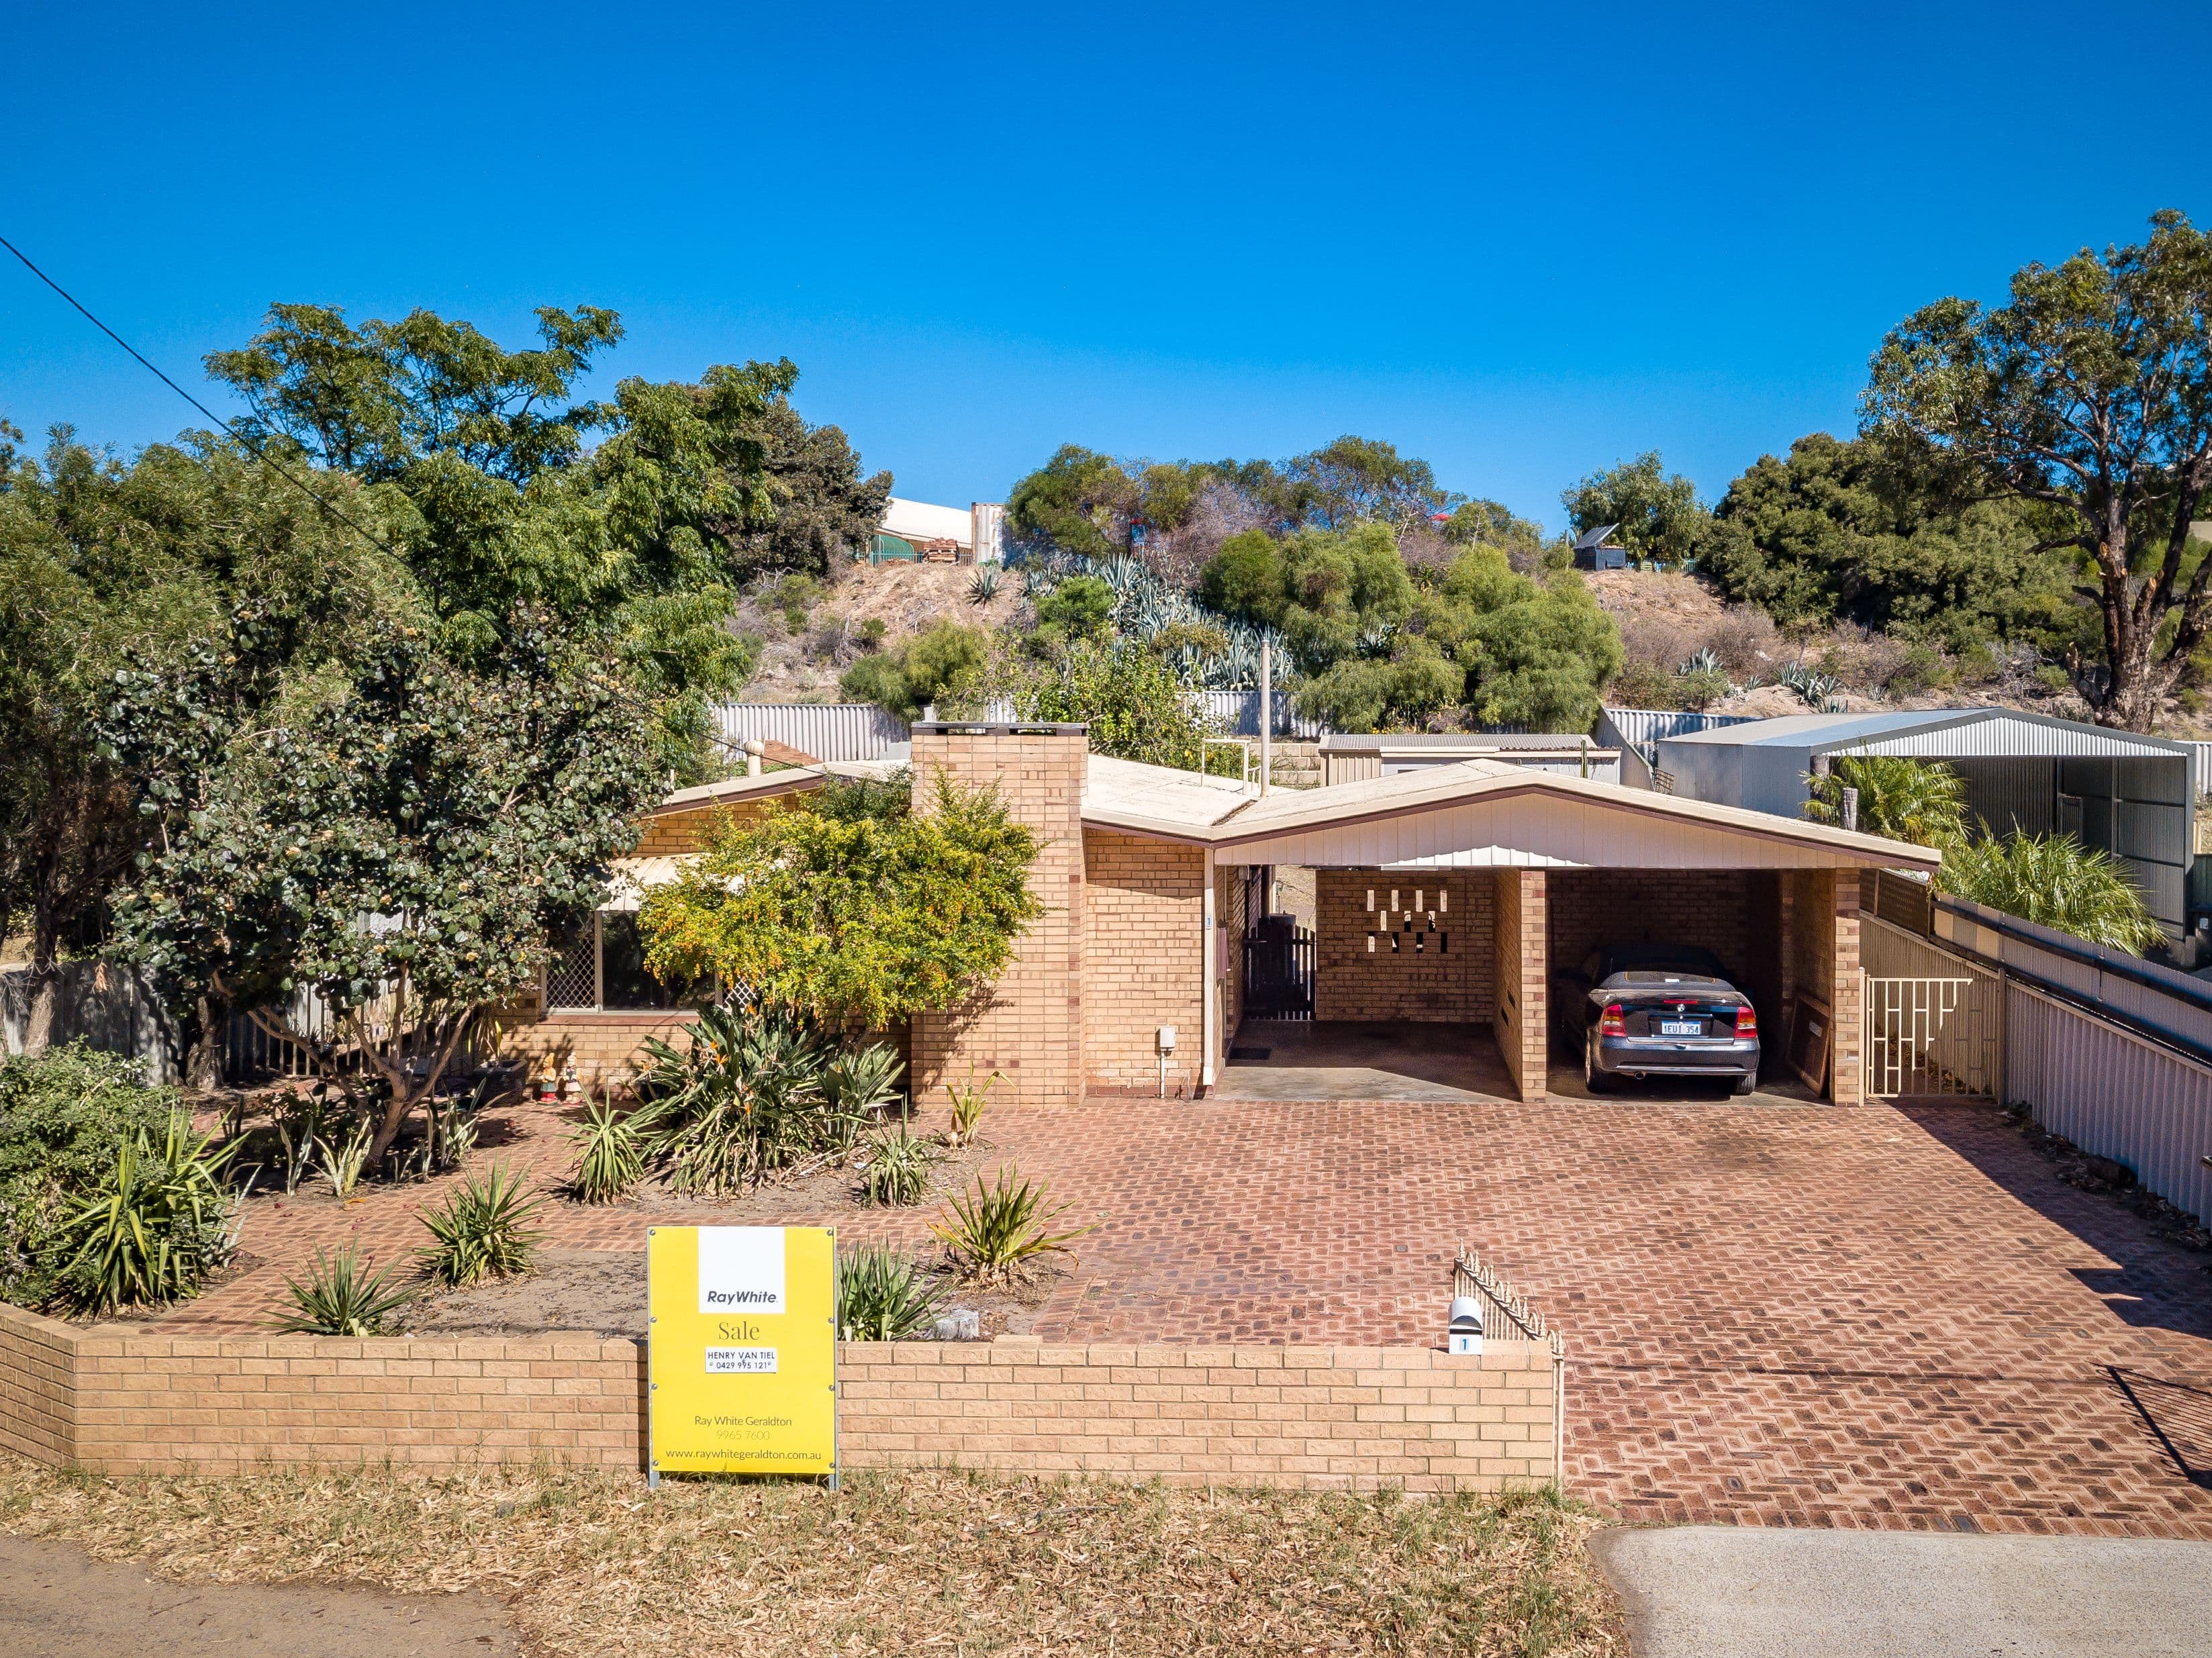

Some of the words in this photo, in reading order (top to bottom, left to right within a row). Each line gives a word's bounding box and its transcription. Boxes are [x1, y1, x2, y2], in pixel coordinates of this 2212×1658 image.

[1686, 1026, 1698, 1034] 354
[718, 1320, 760, 1340] Sale
[1462, 1338, 1467, 1350] 1
[708, 1351, 736, 1359] HENRY
[738, 1351, 758, 1359] VAN
[760, 1351, 775, 1359] TIEL
[694, 1415, 712, 1427] Ray
[714, 1416, 744, 1426] White
[745, 1416, 792, 1426] Geraldton
[716, 1430, 742, 1440] 9965
[745, 1430, 770, 1441] 7600
[665, 1449, 821, 1461] www.raywhitegeraldton.com.au
